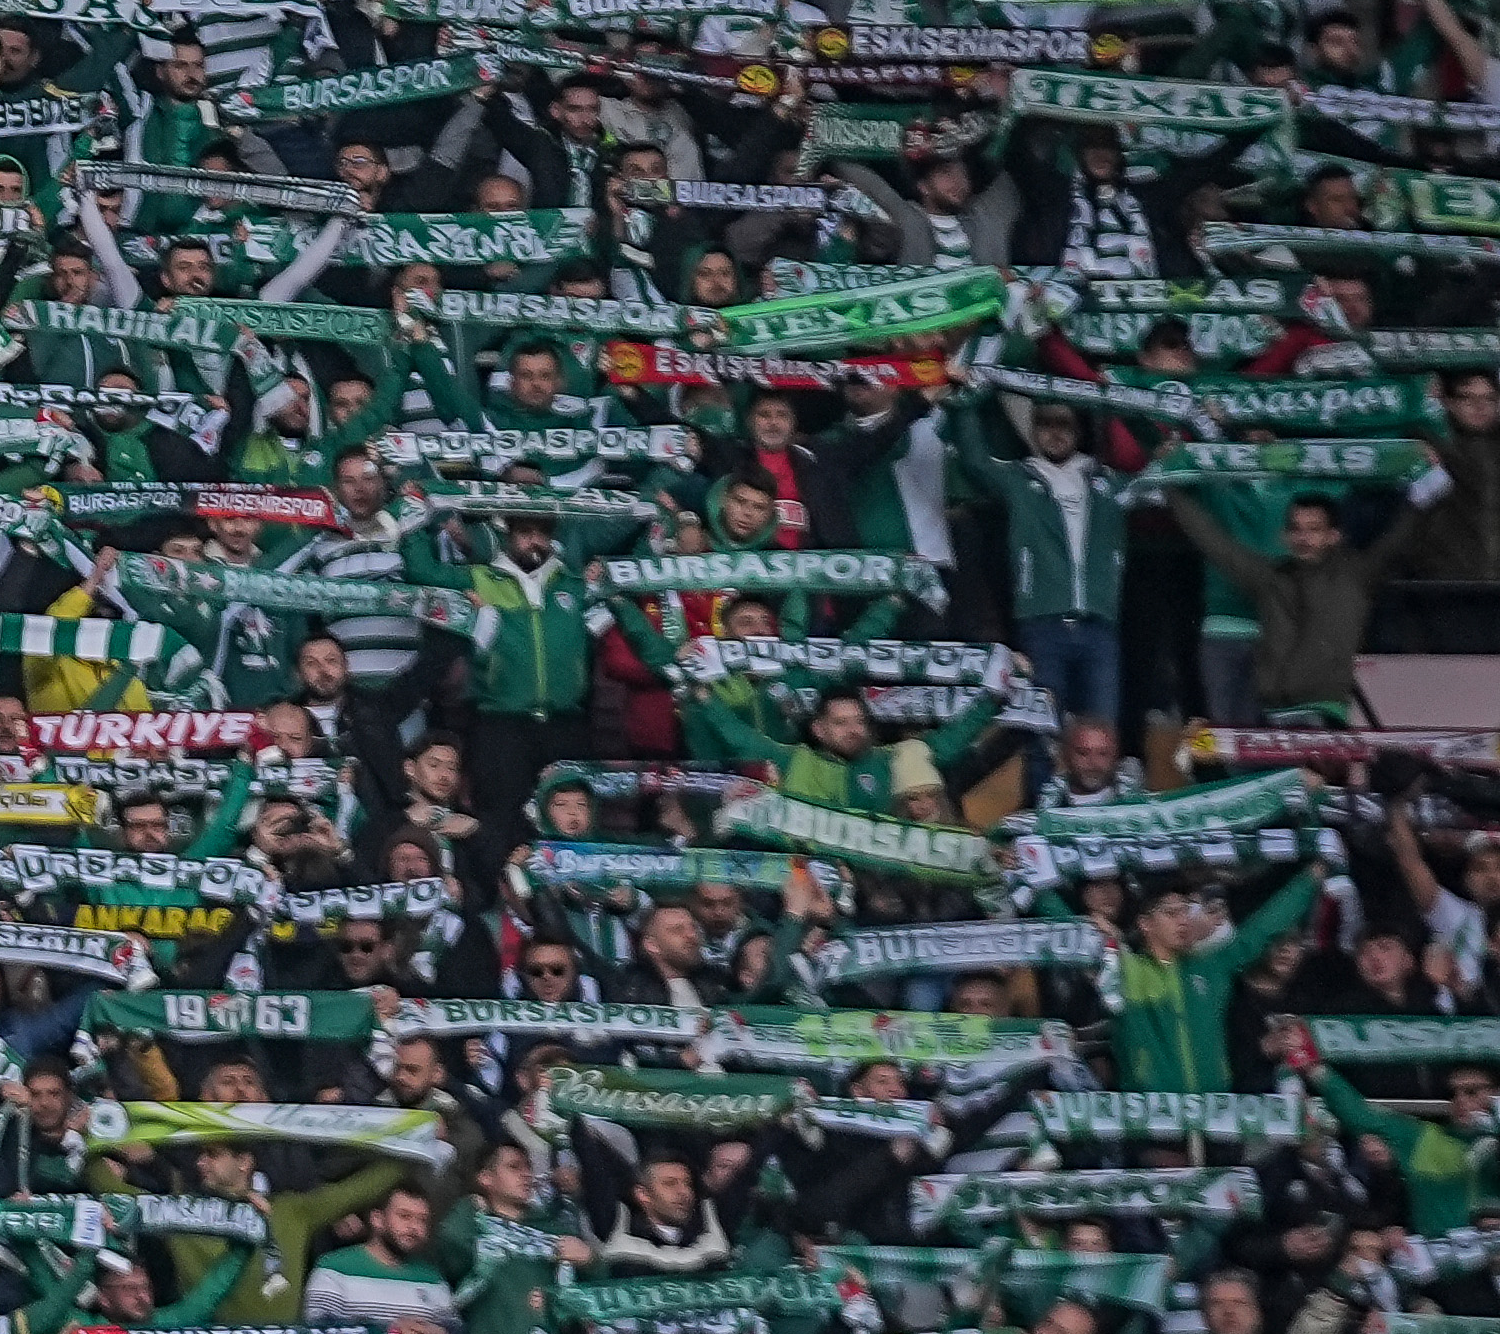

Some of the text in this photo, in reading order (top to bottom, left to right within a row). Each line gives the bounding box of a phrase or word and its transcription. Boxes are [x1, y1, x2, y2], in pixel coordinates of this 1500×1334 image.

[283, 62, 451, 111] BURSASPOR
[1039, 73, 1283, 116] TEXAS
[440, 292, 678, 331] BURSASPOR
[750, 284, 951, 336] TEXAS
[1098, 279, 1282, 310] TEXAS
[47, 301, 224, 351] RADİKAL
[606, 555, 895, 590] BURSASPOR
[33, 710, 258, 749] TÜRKİYE
[0, 847, 268, 901] BURSASPOR
[163, 993, 310, 1029] 19 63
